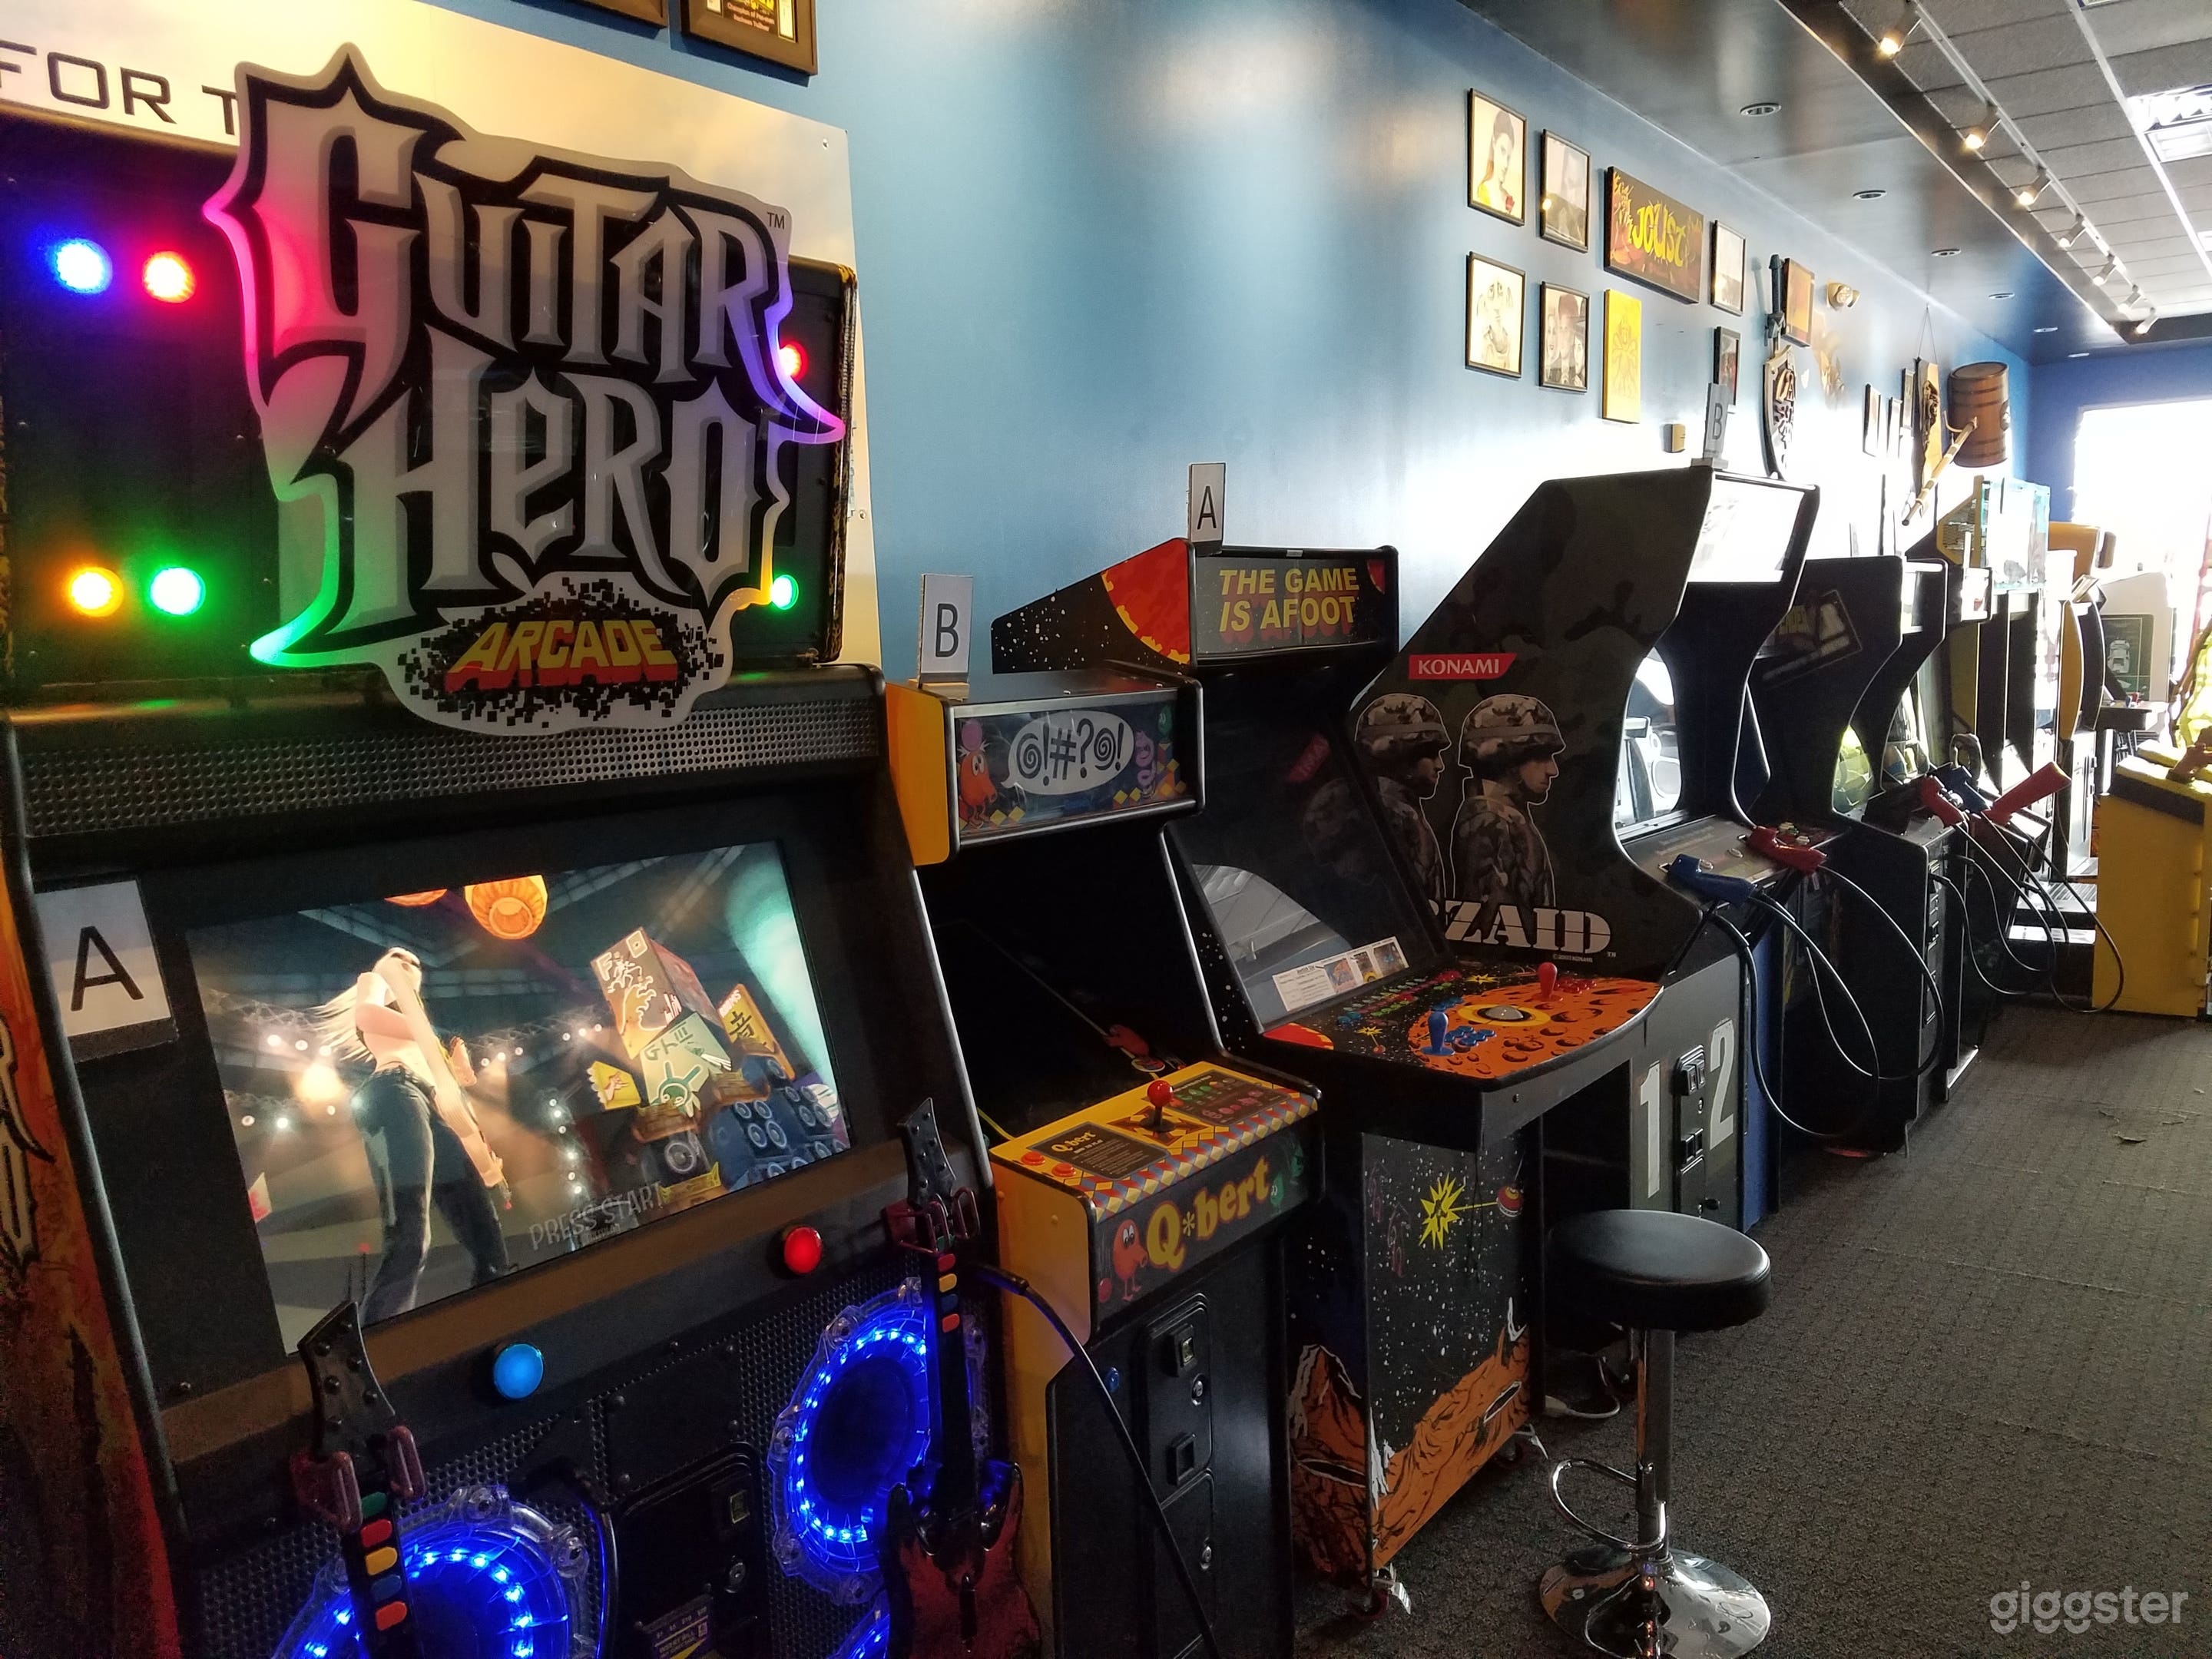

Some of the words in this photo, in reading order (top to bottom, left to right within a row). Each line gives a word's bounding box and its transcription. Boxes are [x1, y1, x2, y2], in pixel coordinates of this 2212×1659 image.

[0, 39, 177, 124] FOR
[767, 211, 785, 229] TM
[253, 84, 797, 420] GUITAR
[1712, 402, 1723, 440] B
[1197, 485, 1217, 531] A
[1219, 569, 1276, 596] THE
[1284, 568, 1360, 593] GAME
[935, 603, 959, 658] B
[1219, 600, 1251, 632] IS
[1260, 596, 1356, 629] AFOOT
[445, 620, 679, 688] ARCADE
[1418, 658, 1500, 675] KONAMI
[70, 926, 144, 1012] A
[1710, 1017, 1735, 1151] 2
[1640, 1060, 1661, 1199] 1
[528, 1203, 597, 1251] PRESS
[601, 1181, 664, 1224] START
